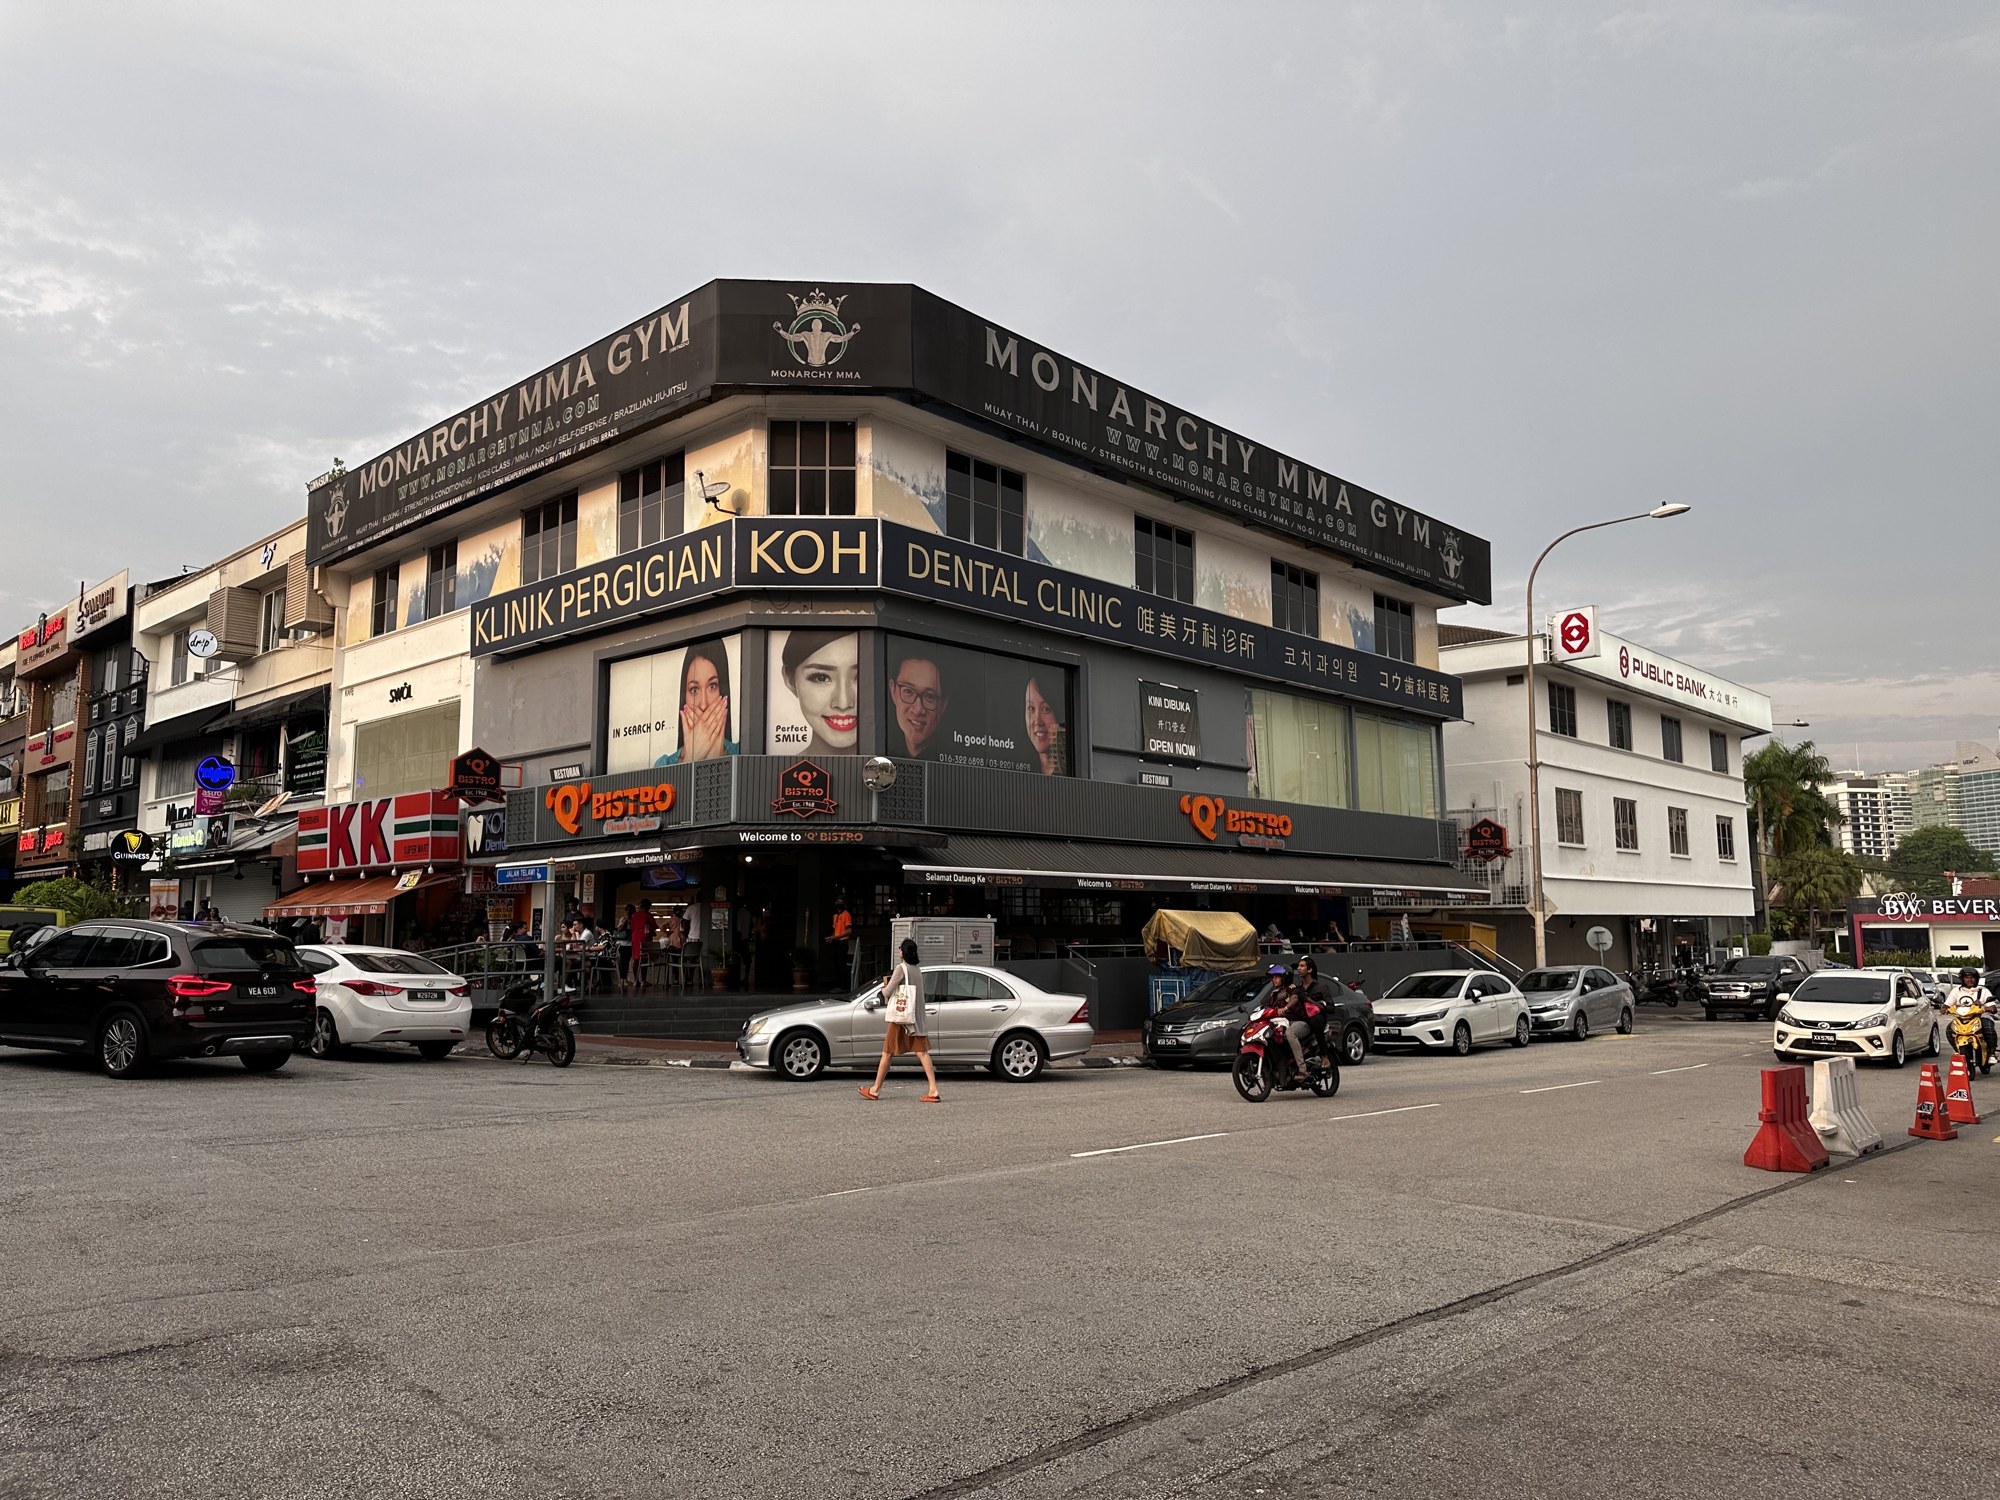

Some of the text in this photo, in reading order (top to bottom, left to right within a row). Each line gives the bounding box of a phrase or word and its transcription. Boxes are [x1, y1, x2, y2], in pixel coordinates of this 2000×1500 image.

[771, 370, 833, 378] MONARCHY
[359, 301, 690, 499] MONARCHY MMA GYM
[559, 450, 572, 460] TINJU
[600, 428, 619, 441] BRAZIL
[984, 326, 1431, 549] MONARCHY MMA GYM
[382, 510, 400, 524] BOXING
[404, 496, 430, 513] STRENGTH
[435, 476, 473, 498] CONDITIONING
[477, 468, 491, 480] KIDS
[491, 459, 510, 474] CLASS
[558, 416, 608, 444] SELF-DEFENSE
[614, 396, 653, 420] BRAZILIAN
[654, 380, 688, 403] JIU-JITSU
[1106, 426, 1357, 538] WWW.MONARCHYMMA.COM
[984, 402, 1012, 420] MUAY
[1016, 414, 1039, 432] THAI
[1052, 429, 1088, 450] BOXING
[1099, 448, 1146, 473] STRENGTH
[1156, 470, 1215, 498] CONDITIONING
[1224, 496, 1242, 509] KIDS
[1244, 504, 1267, 518] CLASS
[1296, 524, 1315, 536] NO-GI
[1322, 532, 1368, 556] SELF-DEFENSE
[1374, 551, 1404, 570] BRAZILIAN
[1406, 564, 1431, 578] JIU-JITSU
[750, 528, 867, 575] KOH
[474, 534, 722, 647] KLINIK PERGIGIAN
[906, 542, 1122, 629] DENTAL CLINIC
[1137, 605, 1255, 660] 唯美牙科诊所
[1632, 658, 1707, 700] PUBLIC BANK
[1148, 695, 1191, 713] KINI DIBUKA
[612, 728, 621, 739] IN
[623, 722, 652, 737] SEARCH
[776, 724, 808, 732] Perfect
[774, 733, 808, 743] SMILE
[954, 730, 1014, 750] In good hands
[1150, 738, 1196, 756] OPEN NOW
[458, 774, 496, 785] BISTRO
[554, 766, 580, 780] RESTORAN
[1142, 773, 1170, 786] RESTORAN
[784, 788, 824, 796] BISTRO
[592, 783, 676, 820] BISTRO
[1226, 809, 1292, 837] BISTRO
[329, 798, 392, 868] KK
[739, 832, 788, 842] Welcome
[791, 832, 802, 842] to
[820, 832, 864, 842] BISTRO
[1472, 838, 1500, 846] BISTRO
[114, 852, 150, 860] GUINNESS
[625, 855, 644, 865] Selamat
[646, 854, 664, 863] Datang
[664, 852, 672, 860] Ke
[506, 868, 536, 878] JALAN TELAWI
[926, 872, 952, 881] Selamat
[953, 874, 976, 884] Datang
[976, 874, 986, 883] Ke
[996, 876, 1023, 885] BISTRO
[472, 882, 491, 892] BUKA
[508, 884, 526, 892] JAM
[1077, 878, 1145, 889] Welcome to BISTRO
[1190, 882, 1209, 890] Selamat
[1210, 883, 1225, 892] Datang
[1294, 886, 1315, 894] Welcome
[1932, 899, 2000, 914] BEVER
[248, 987, 276, 996] VEA 6131
